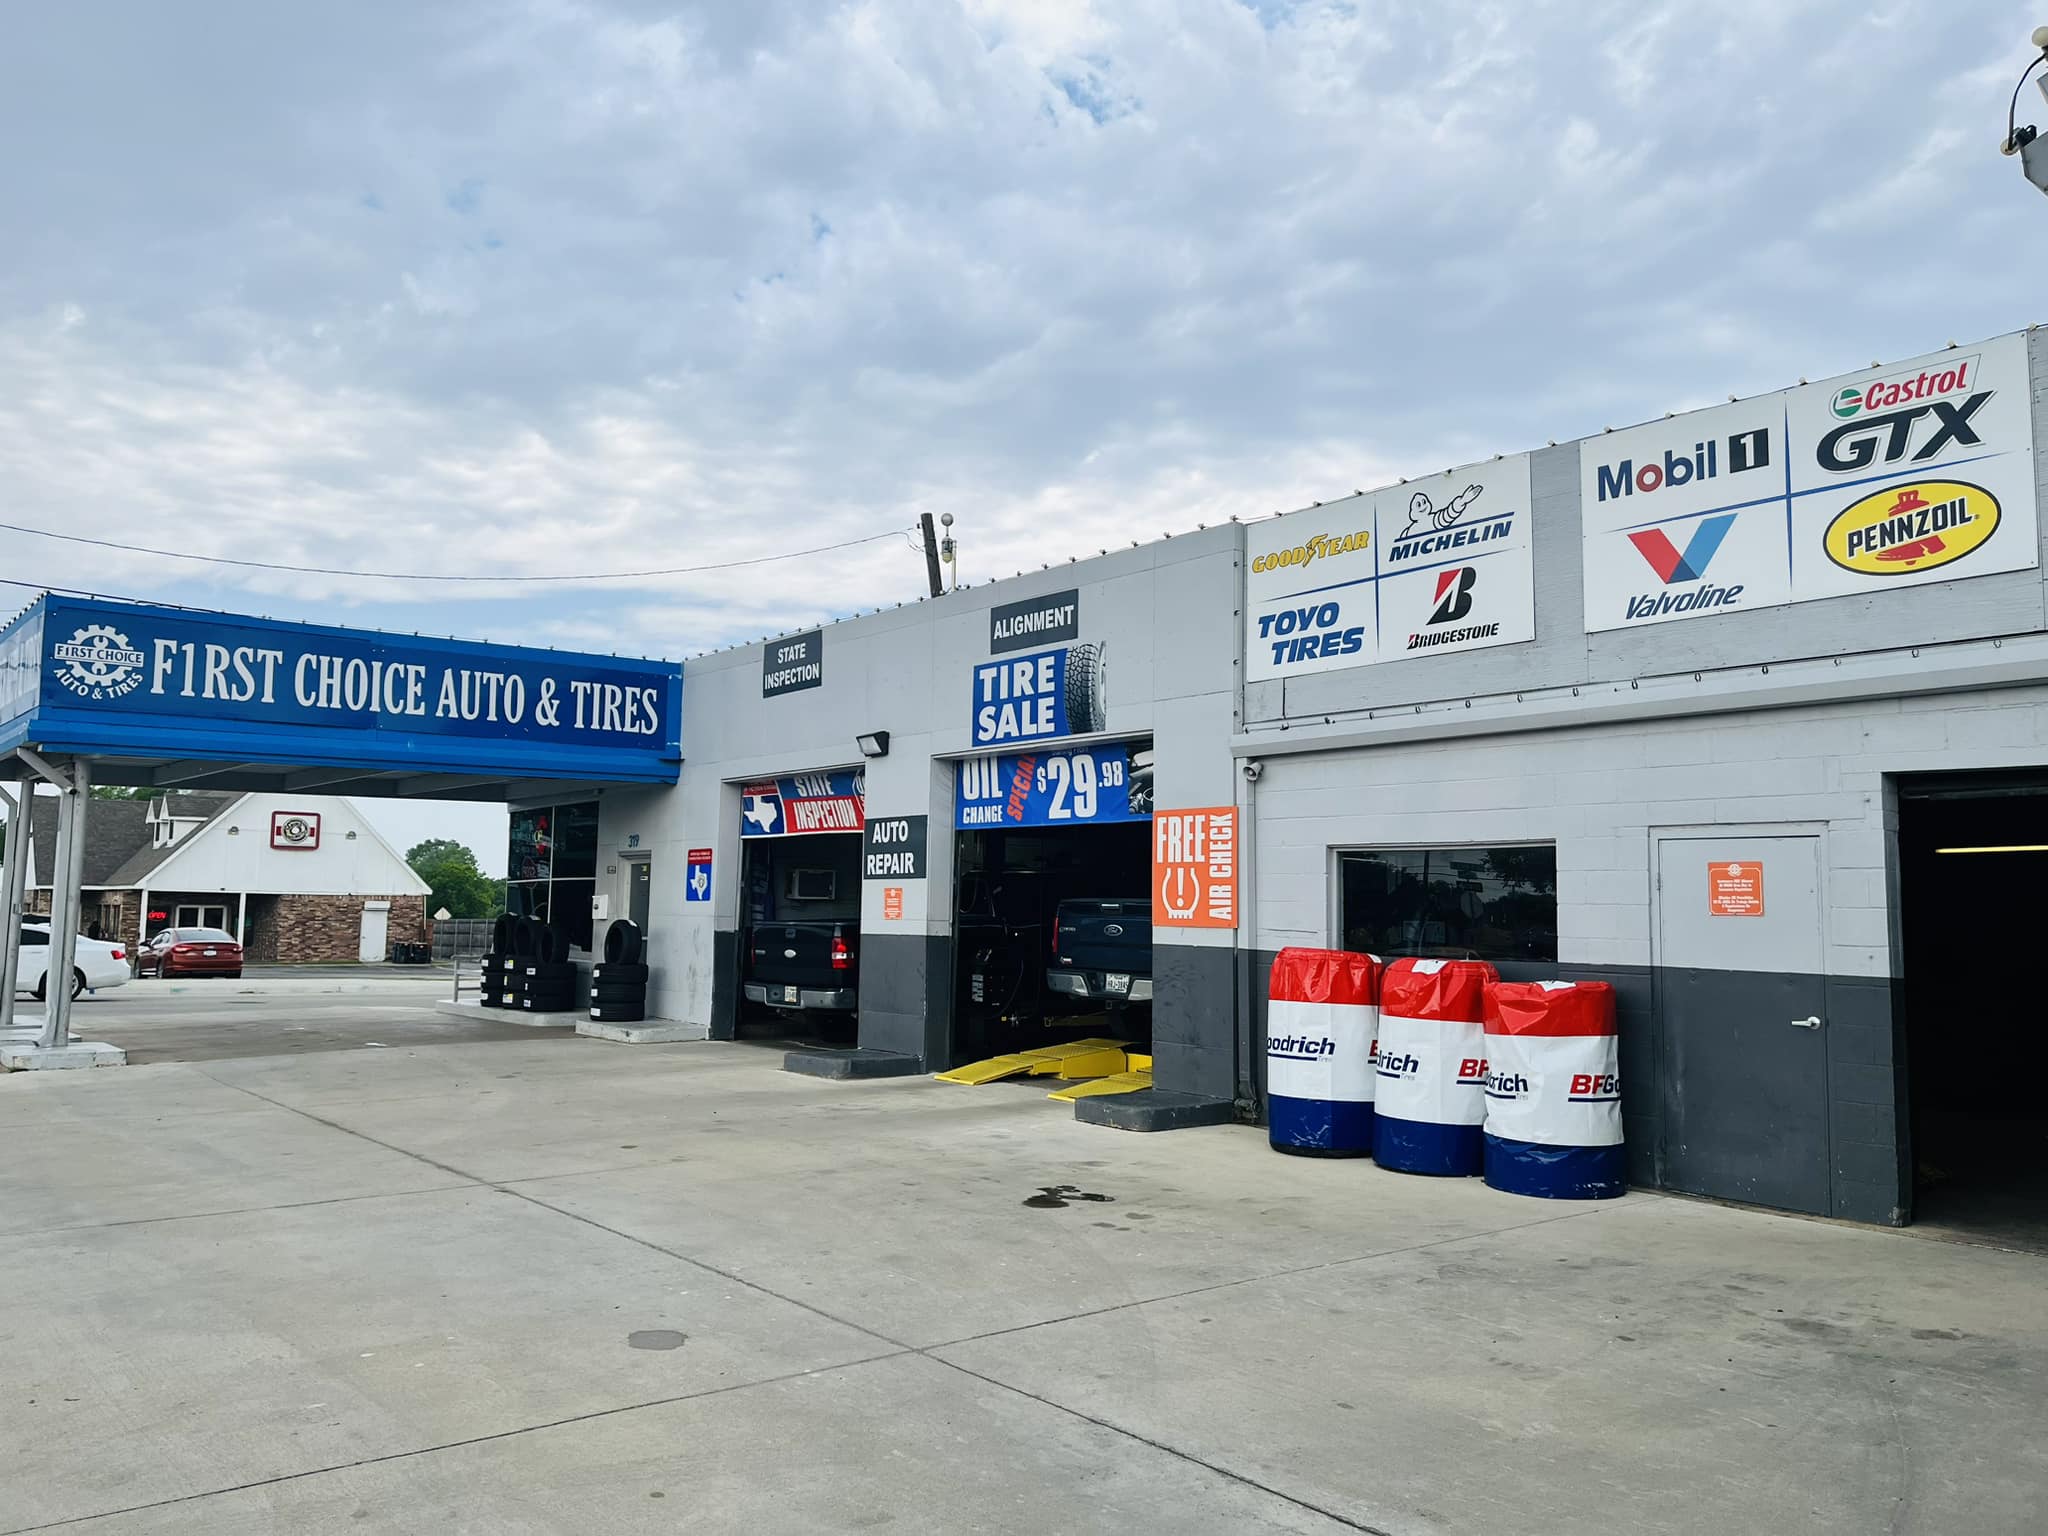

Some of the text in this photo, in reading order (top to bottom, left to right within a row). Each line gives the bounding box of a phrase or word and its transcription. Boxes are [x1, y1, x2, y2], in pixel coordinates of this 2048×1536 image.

[1865, 362, 1968, 411] Castrol
[1816, 390, 1995, 472] GTX
[1597, 440, 1717, 502] Mobil
[1389, 520, 1513, 562] MICHELIN
[1847, 497, 1973, 558] PENNZOIL
[1251, 530, 1370, 574] GOODYEAR
[1258, 601, 1340, 639] TOYO
[1625, 584, 1744, 620] Valvoline
[993, 604, 1075, 640] ALIGNMENT
[1406, 622, 1500, 650] BRIDGESTONE
[96, 649, 142, 664] CHOICE
[777, 642, 806, 664] STATE
[1271, 626, 1365, 666] TIRES
[53, 668, 144, 700] AUTO & TIRES
[150, 638, 659, 735] F1RST CHOICE AUTO & TIRES
[764, 662, 820, 690] INSPECTION
[979, 655, 1056, 703] TIRE
[977, 696, 1056, 742] SALE
[793, 774, 834, 797] STATE
[962, 756, 1003, 800] OIL
[793, 798, 858, 830] INSPECTION
[872, 820, 909, 844] AUTO
[962, 804, 1003, 825] CHANGE
[1156, 814, 1206, 864] FREE
[866, 852, 915, 876] REPAIR
[1208, 812, 1233, 921] AIR CHECK
